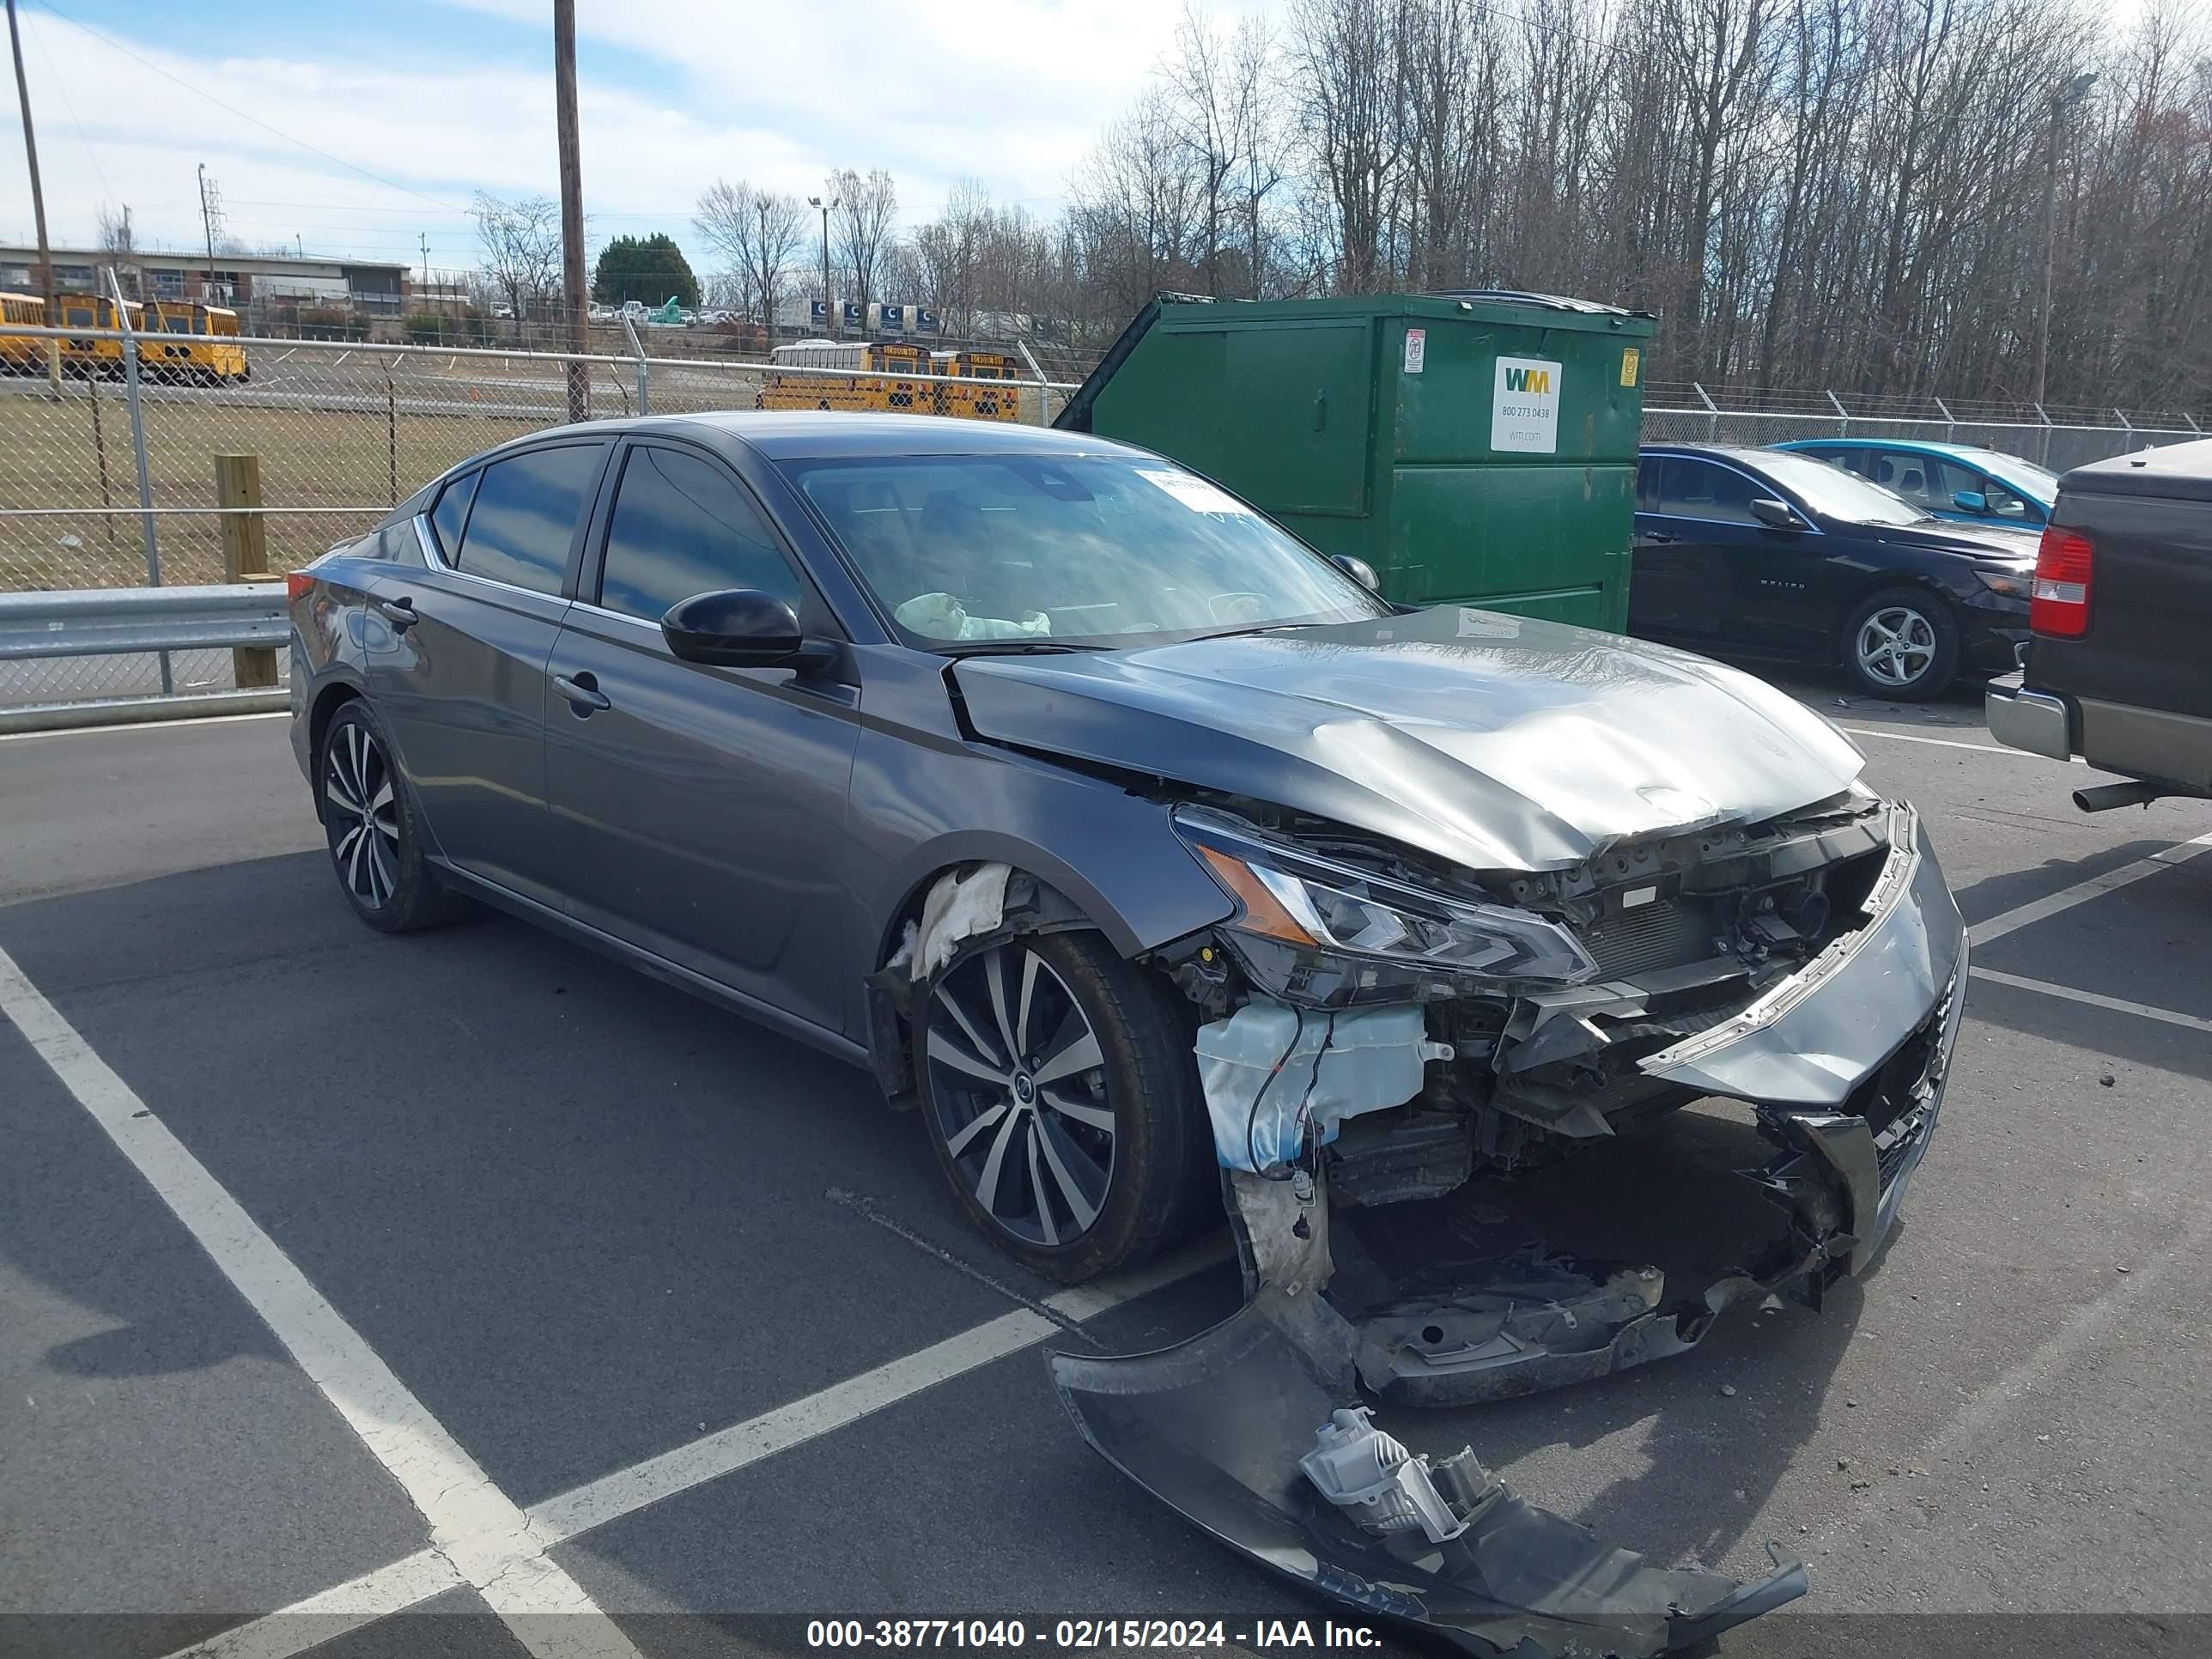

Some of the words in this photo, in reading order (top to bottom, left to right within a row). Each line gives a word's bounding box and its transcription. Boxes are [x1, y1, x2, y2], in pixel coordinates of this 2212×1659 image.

[1505, 368, 1550, 394] WM
[1502, 405, 1516, 416] 800
[1517, 407, 1530, 417] 273
[1532, 408, 1550, 418] 0438
[1510, 431, 1541, 441] wm.com
